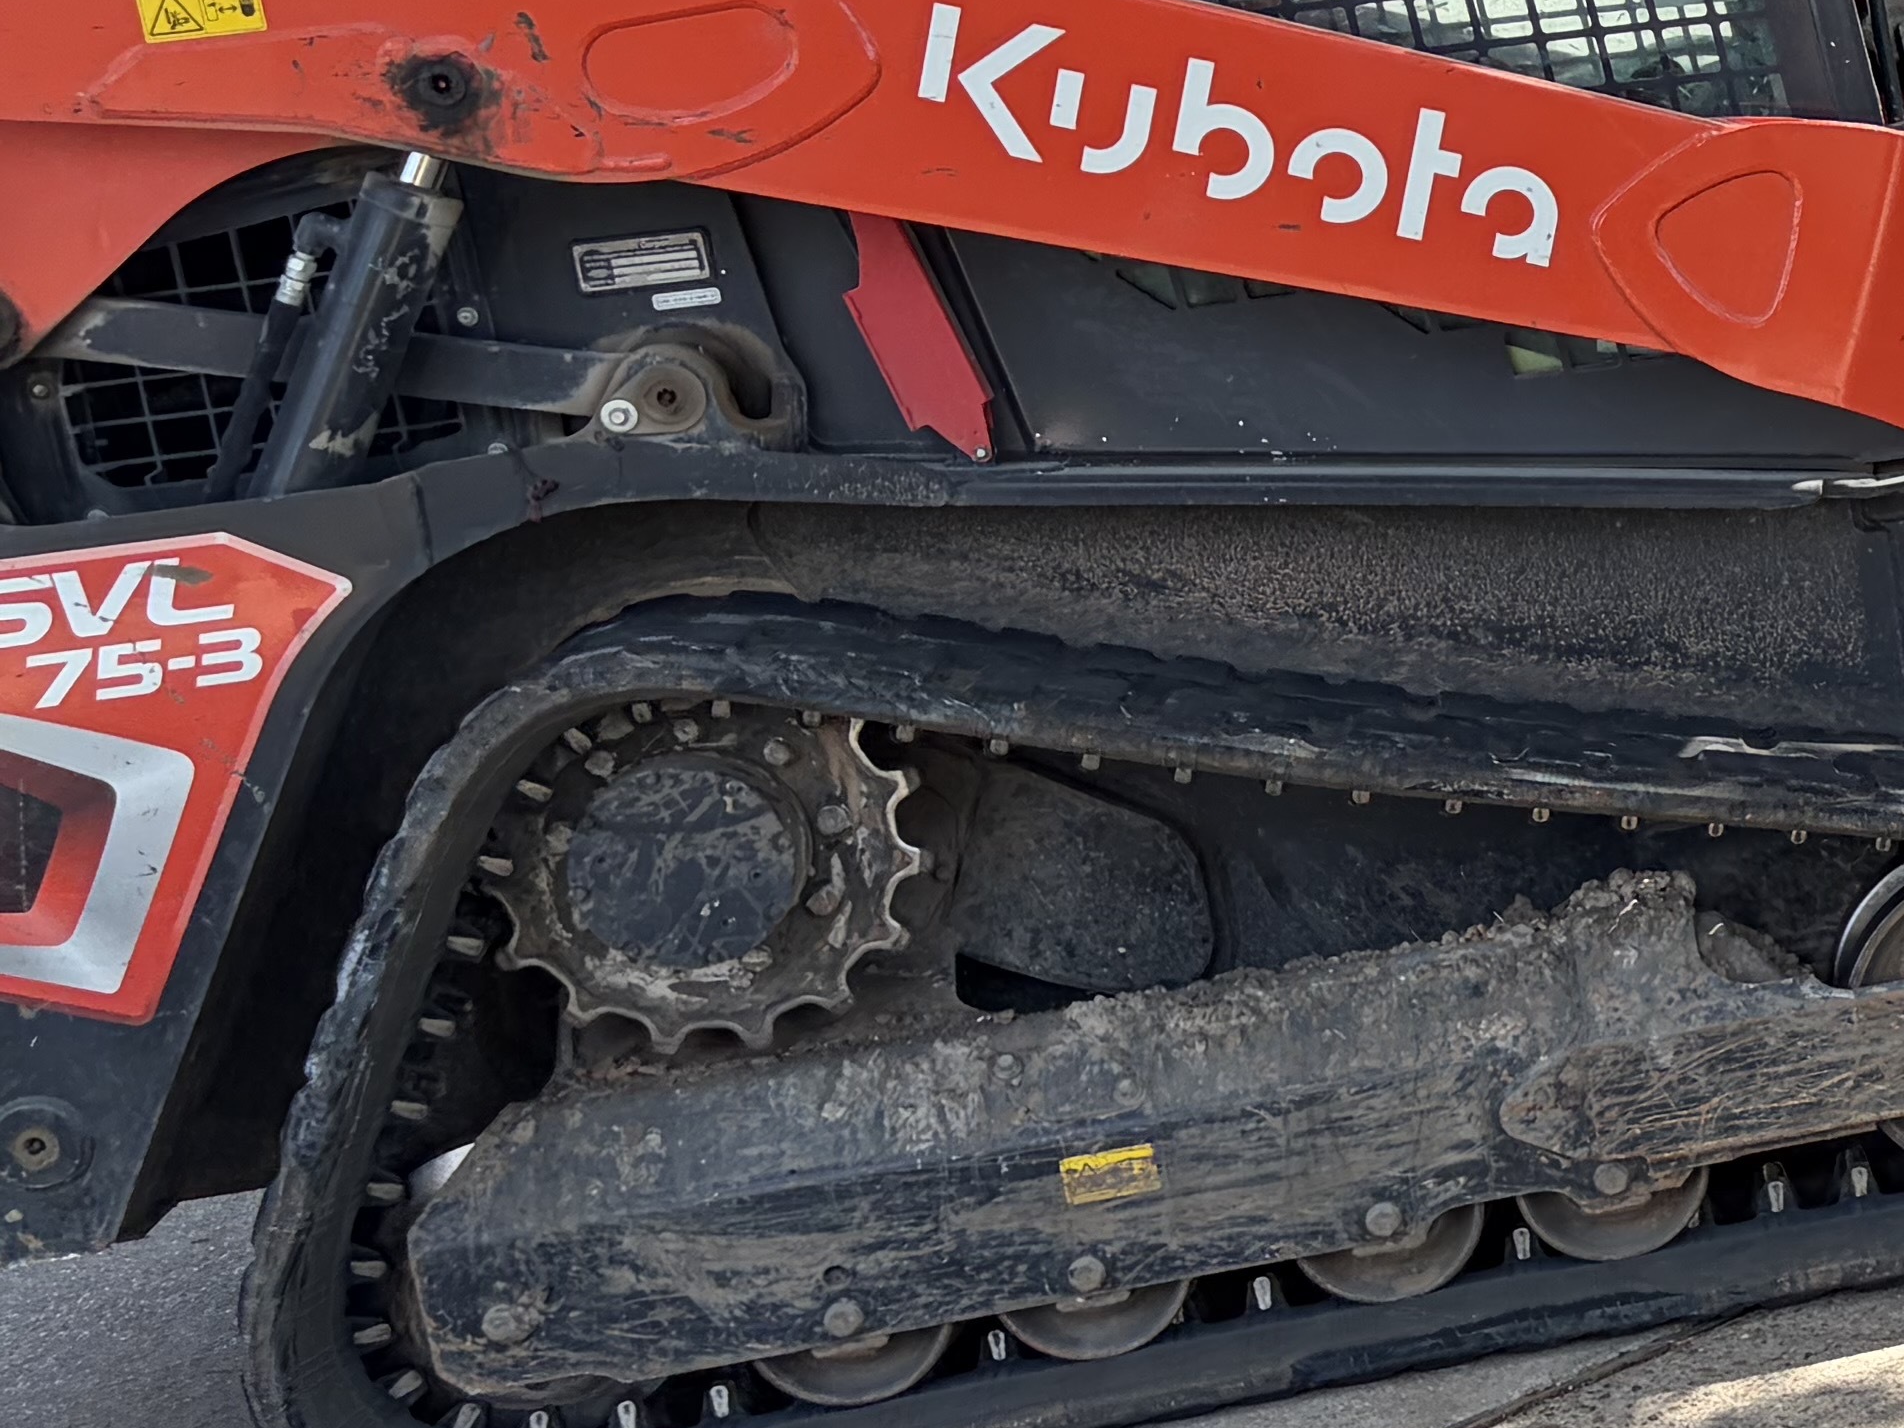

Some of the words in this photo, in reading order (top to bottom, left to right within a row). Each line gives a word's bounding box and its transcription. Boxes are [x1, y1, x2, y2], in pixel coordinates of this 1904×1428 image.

[917, 2, 1559, 267] Kubota
[0, 557, 235, 648] SVL
[26, 627, 264, 710] 75-3
